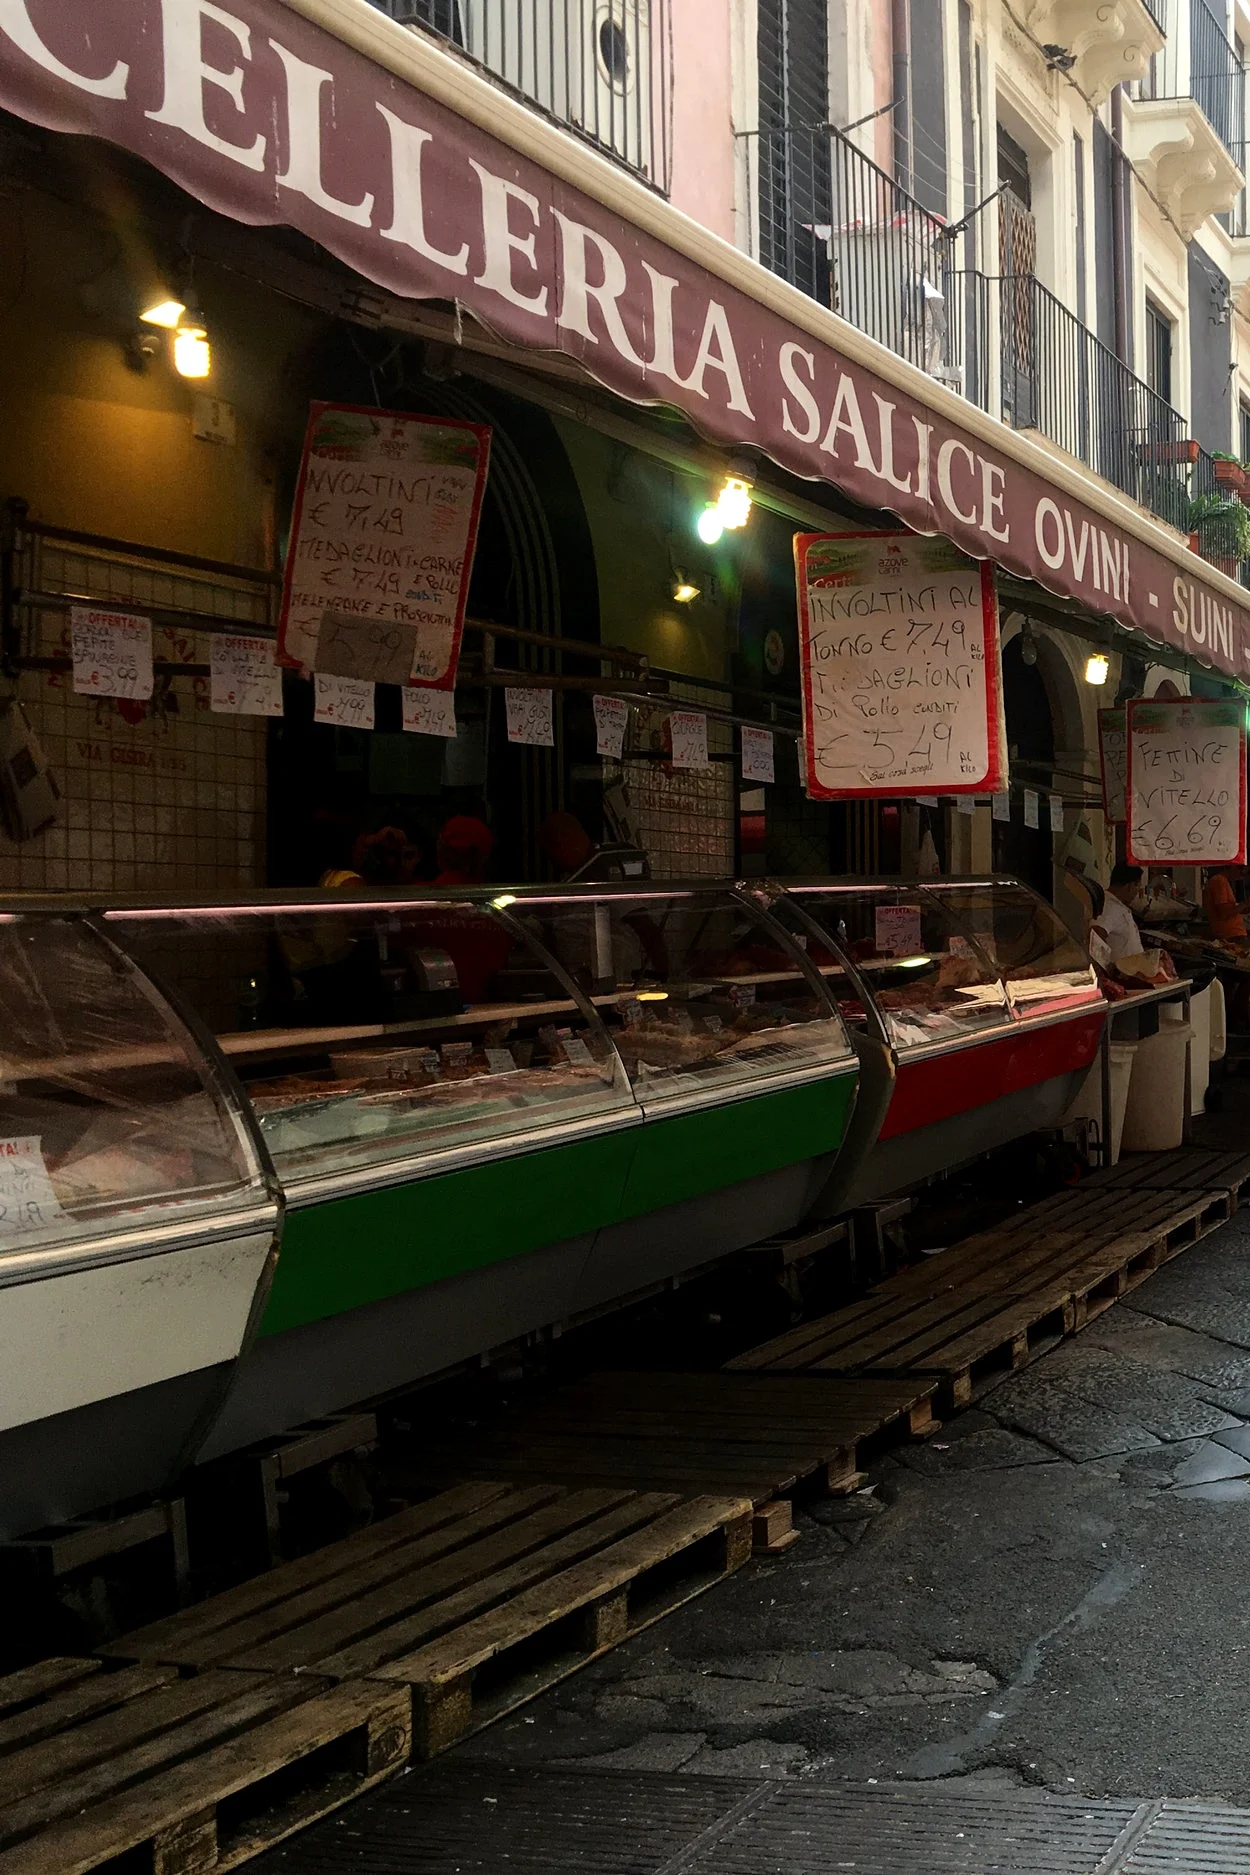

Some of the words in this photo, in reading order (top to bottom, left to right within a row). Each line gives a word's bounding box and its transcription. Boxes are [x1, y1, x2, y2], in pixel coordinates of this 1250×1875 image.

[779, 341, 1011, 544] SALICE
[1034, 498, 1131, 606] OVINI
[1172, 577, 1236, 662] SUINI
